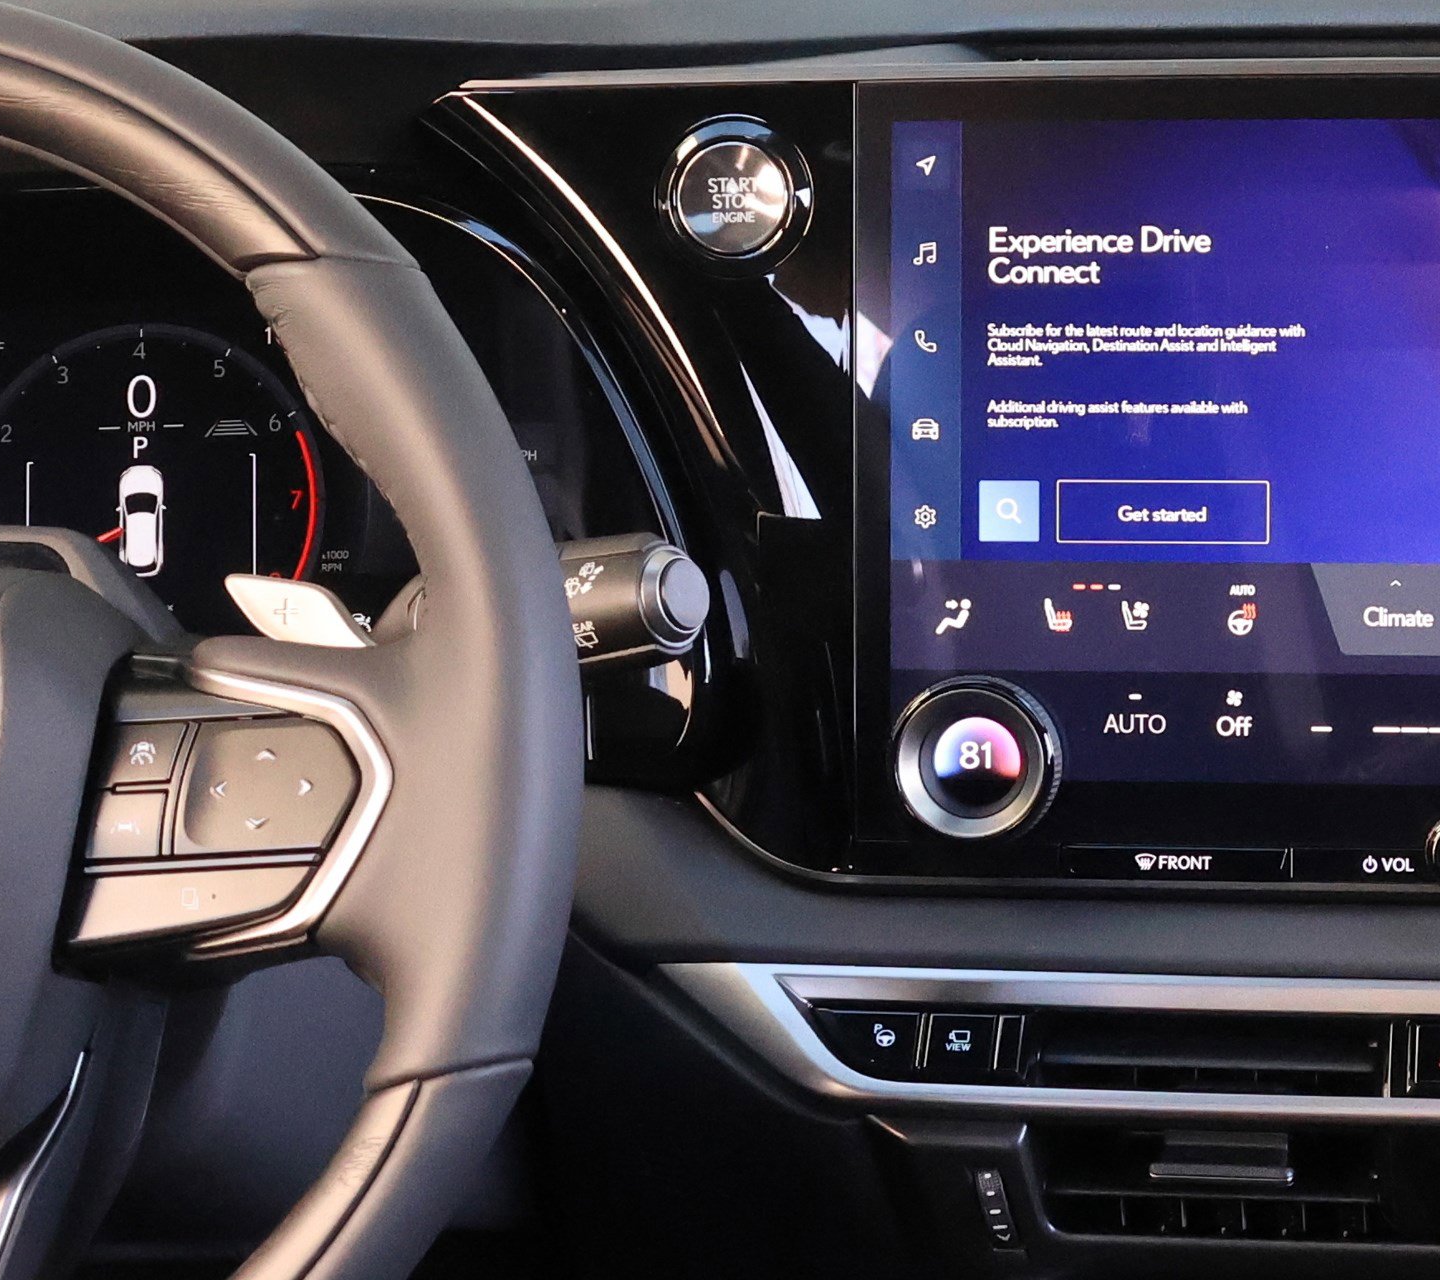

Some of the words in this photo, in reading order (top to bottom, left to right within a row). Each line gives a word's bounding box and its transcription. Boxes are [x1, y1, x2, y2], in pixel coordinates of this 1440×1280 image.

[708, 177, 758, 194] START
[712, 193, 758, 209] STO
[712, 211, 755, 223] ENGINE
[988, 226, 1134, 259] Experience
[1140, 225, 1212, 254] Drive
[988, 256, 1101, 284] Connect
[987, 323, 1043, 337] Subscribe
[1045, 324, 1062, 337] for
[1065, 324, 1083, 337] the
[1086, 324, 1119, 337] latest
[1120, 325, 1152, 337] route
[1154, 324, 1177, 337] and
[1177, 324, 1223, 337] location
[1224, 324, 1277, 340] guidance
[1278, 324, 1306, 337] with
[132, 343, 146, 359] 4
[987, 339, 1024, 352] Cloud
[1025, 339, 1090, 354] Navigation,
[1092, 339, 1159, 352] Destination
[1159, 339, 1195, 352] Assist
[1196, 339, 1219, 352] and
[1220, 339, 1277, 355] Intelligent
[987, 353, 1043, 367] Assistant.
[57, 366, 69, 384] 3
[213, 361, 226, 378] 5
[127, 374, 157, 418] 0
[987, 400, 1045, 413] Additional
[1047, 400, 1086, 416] driving
[1088, 400, 1119, 413] assist
[1121, 400, 1169, 414] features
[1170, 400, 1219, 414] available
[1221, 401, 1248, 414] with
[128, 421, 156, 432] MPH
[269, 414, 281, 432] 6
[987, 415, 1059, 430] subscription.
[0, 424, 12, 443] 2
[132, 437, 148, 459] P
[290, 490, 302, 509] 7
[1117, 503, 1148, 524] Get
[1151, 505, 1207, 523] started
[1229, 584, 1255, 596] AUTO
[1362, 607, 1434, 629] Climate
[572, 621, 595, 633] EAR
[1103, 714, 1166, 735] AUTO
[1216, 715, 1253, 737] Off
[959, 741, 992, 770] 81
[1159, 855, 1211, 871] FRONT
[1381, 857, 1414, 873] VOL
[874, 1024, 883, 1035] P
[945, 1042, 971, 1052] VIEW
